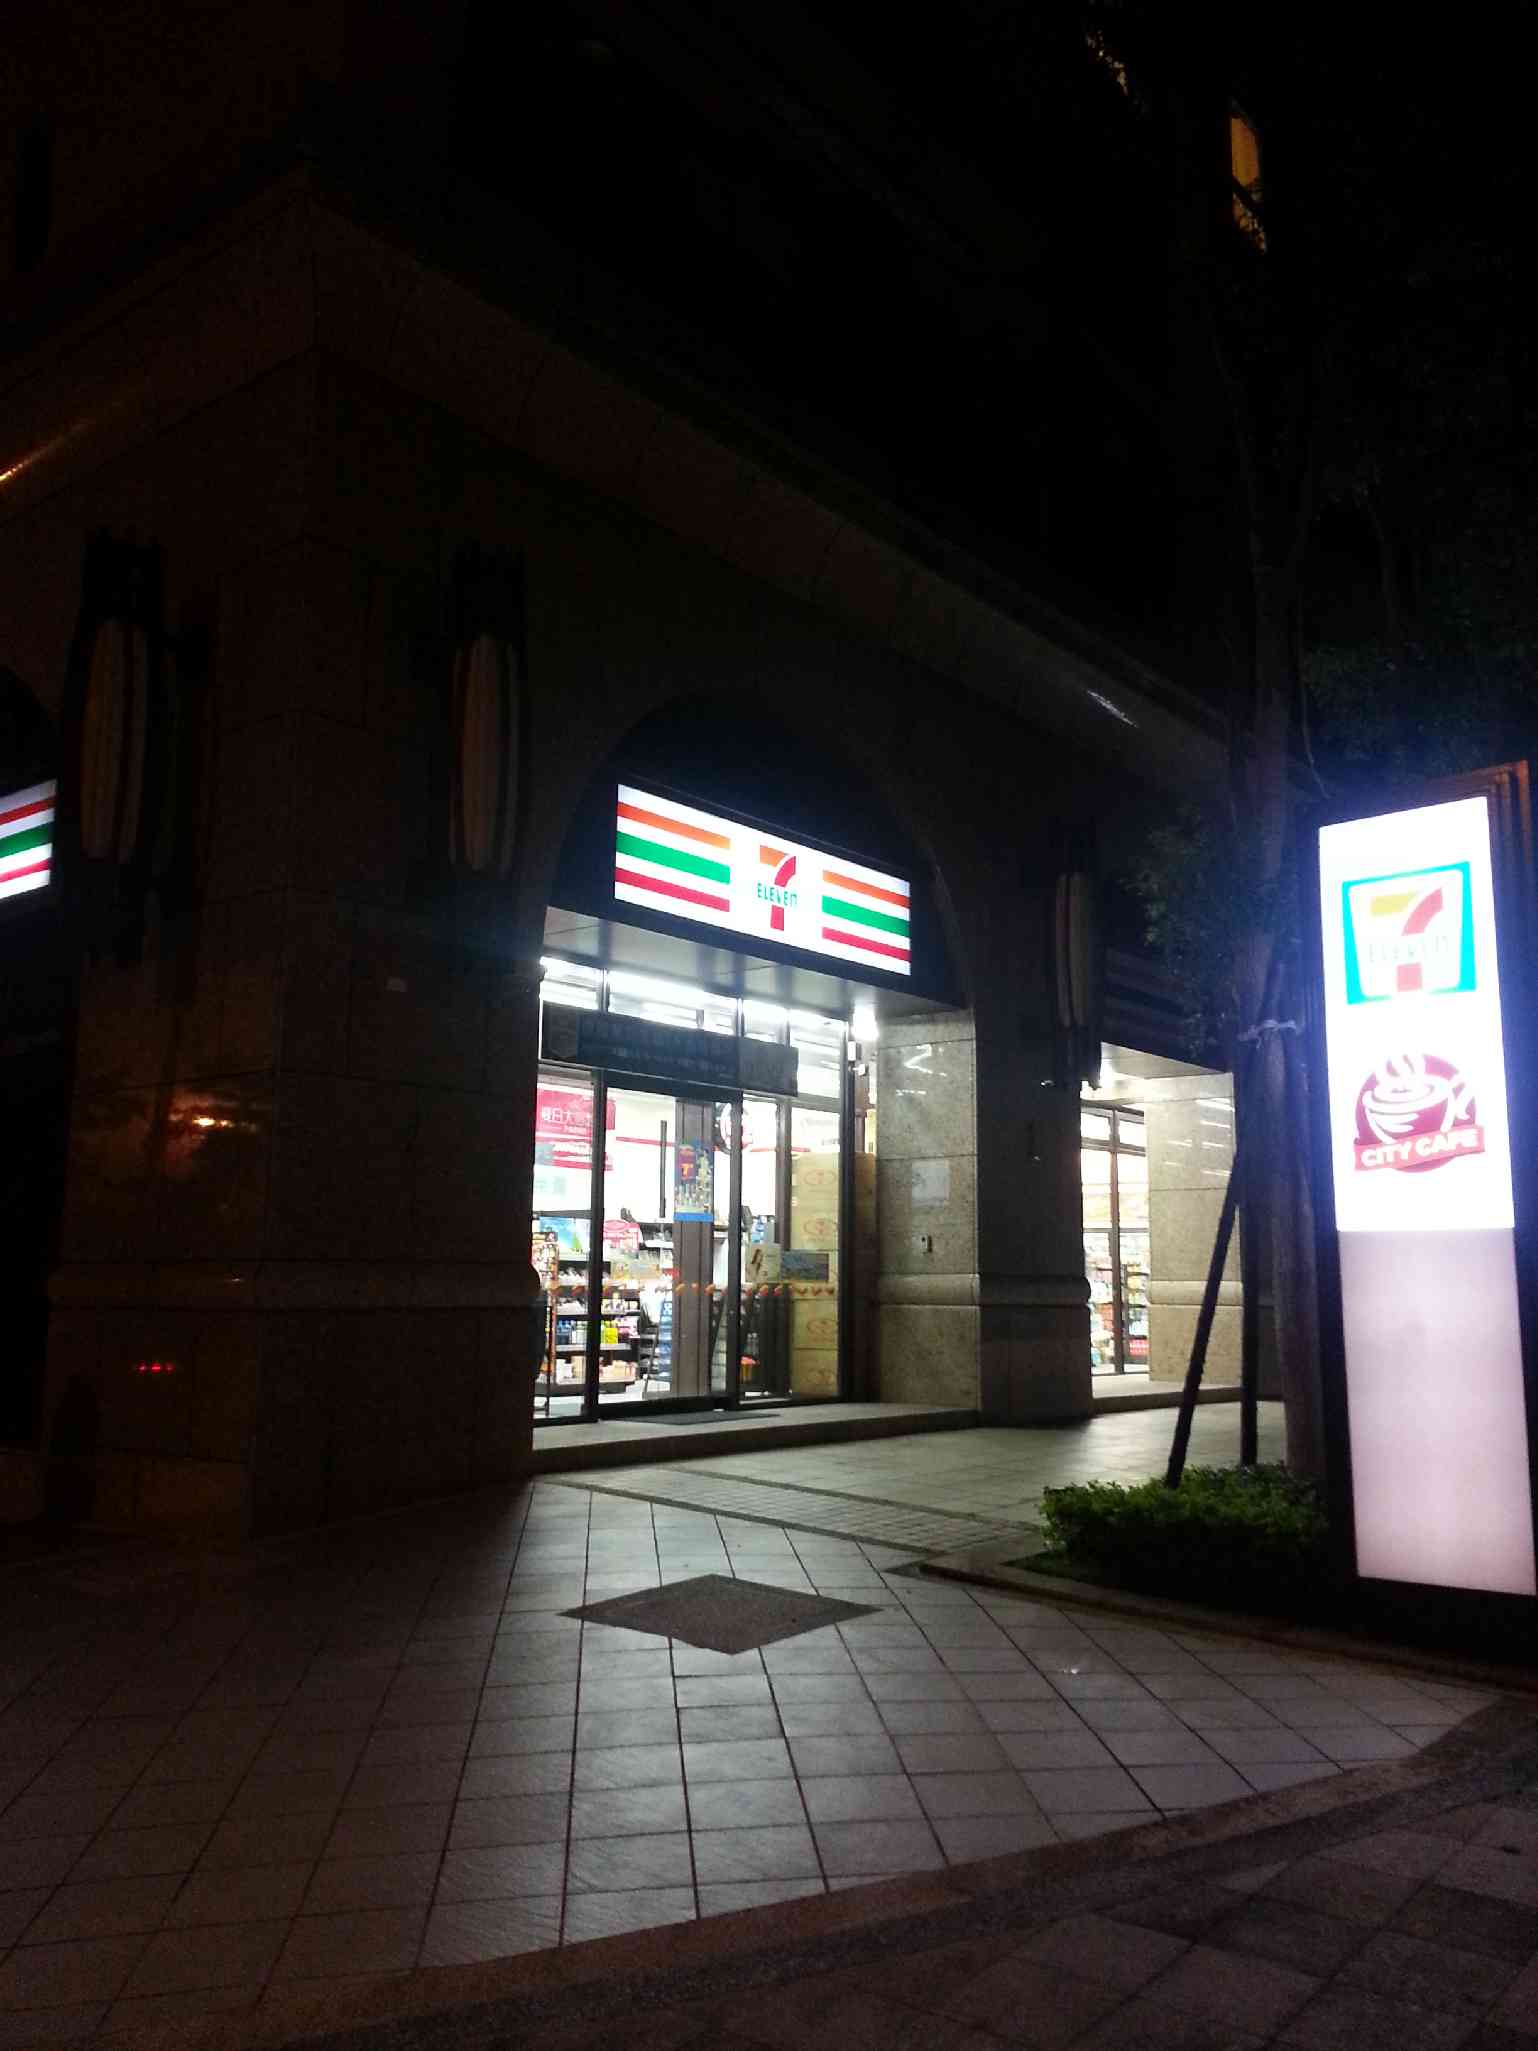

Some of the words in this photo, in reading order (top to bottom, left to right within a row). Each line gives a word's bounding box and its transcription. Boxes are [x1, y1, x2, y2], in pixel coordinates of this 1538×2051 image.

[759, 845, 796, 931] 7
[1369, 887, 1444, 992] 7
[1361, 1140, 1412, 1167] CITY
[1415, 1128, 1479, 1156] CAFE
